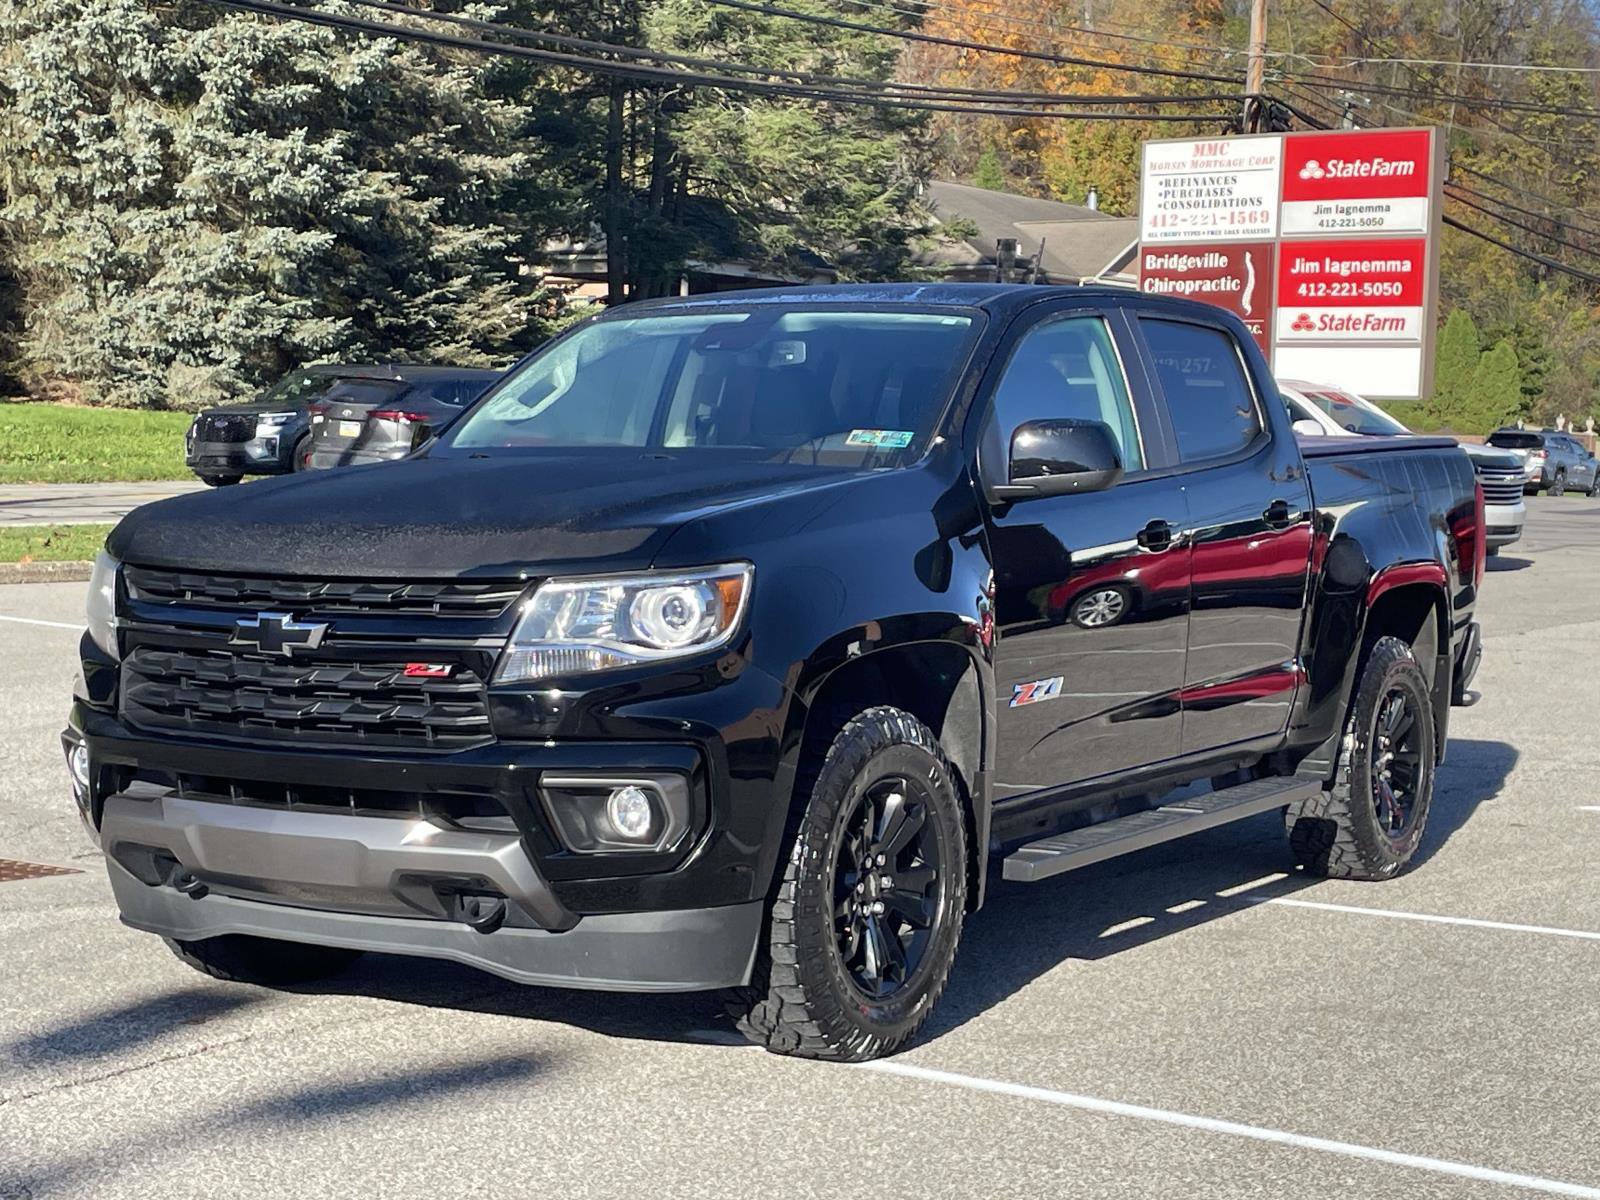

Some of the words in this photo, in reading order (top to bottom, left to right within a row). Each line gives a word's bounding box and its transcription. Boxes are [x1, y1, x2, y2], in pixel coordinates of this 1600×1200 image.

[1192, 141, 1230, 157] MMC
[1190, 158, 1245, 169] MORTGAGE
[1163, 175, 1238, 188] REFINANCES
[1163, 187, 1233, 199] PURCHASES
[1163, 197, 1263, 210] CONSOLIDATIONS
[1314, 204, 1332, 215] Jim
[1335, 204, 1391, 216] Iagnemma
[1149, 210, 1270, 228] 412-221-1569
[1318, 217, 1384, 228] 412-221-5050
[1145, 252, 1228, 272] Bridgeville
[1290, 257, 1320, 274] Jim
[1325, 257, 1412, 277] Iagnemma
[1144, 276, 1241, 295] Chiropractic
[1297, 281, 1403, 297] 412-221-5050
[403, 662, 453, 677] Z71
[1009, 675, 1064, 708] Z71
